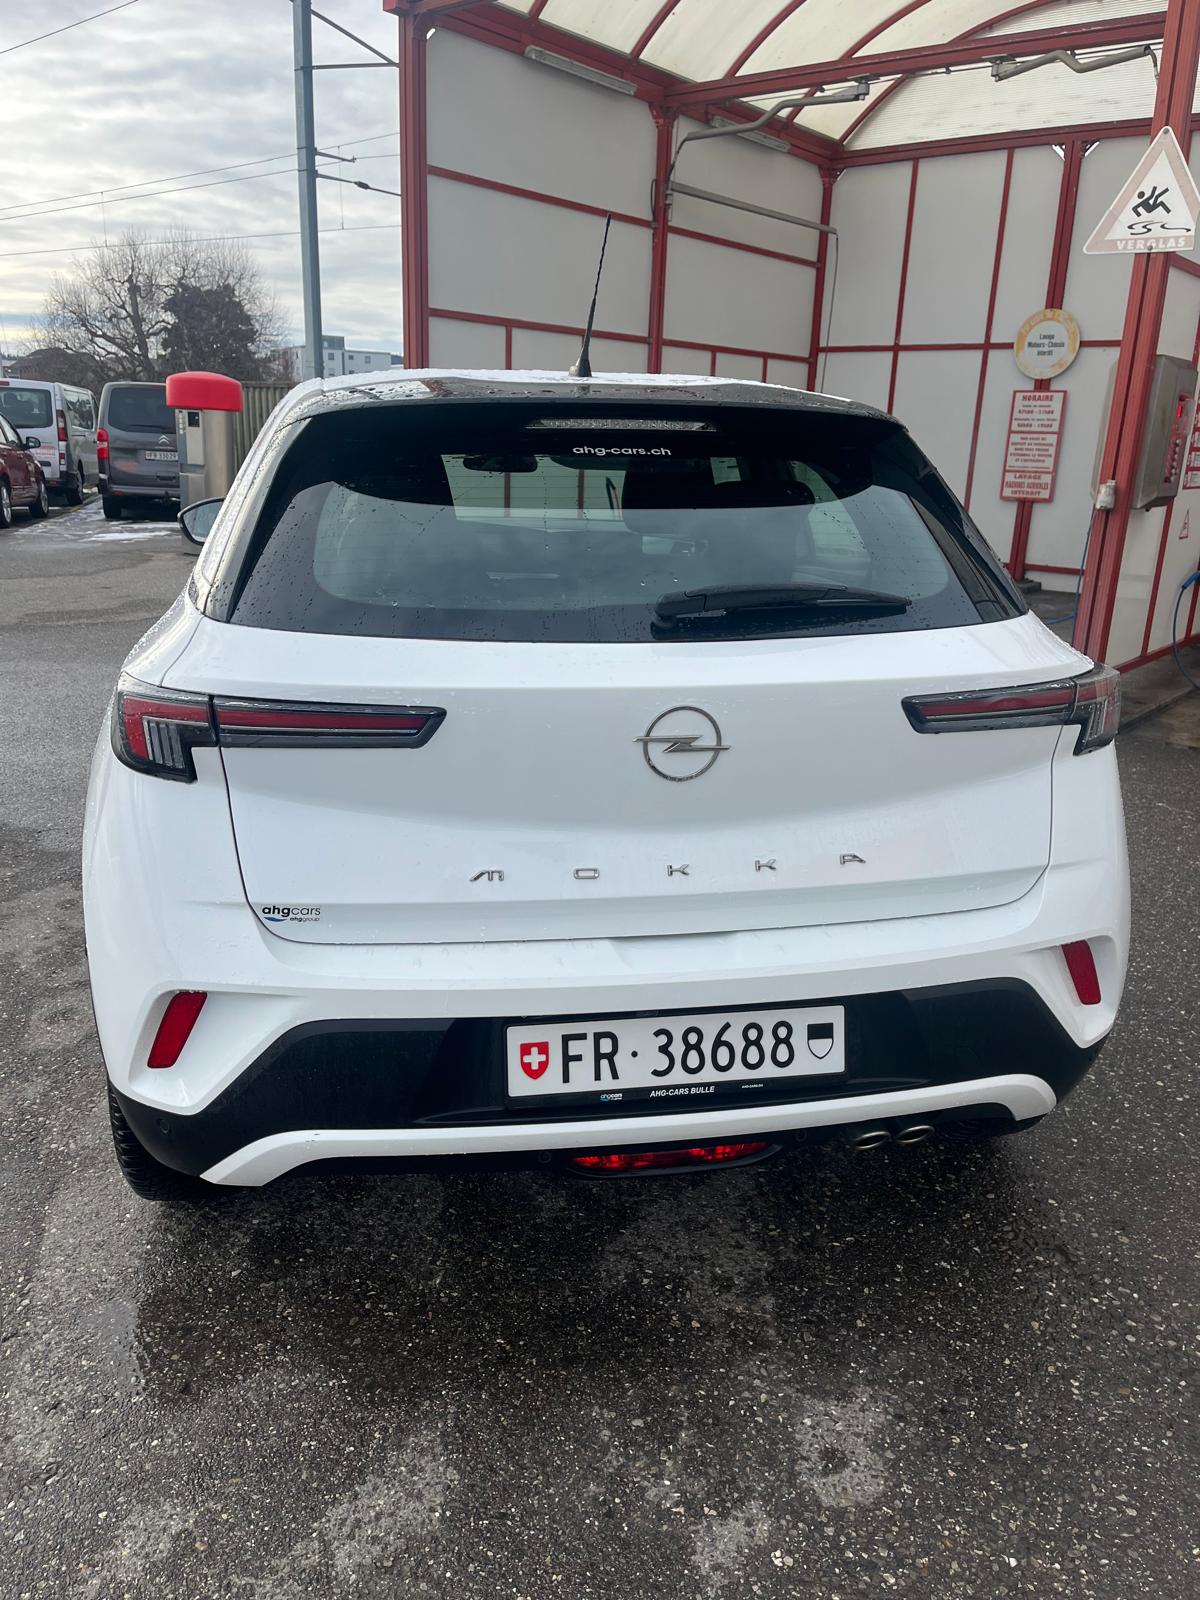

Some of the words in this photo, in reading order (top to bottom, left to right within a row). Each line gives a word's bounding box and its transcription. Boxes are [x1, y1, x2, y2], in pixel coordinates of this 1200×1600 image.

[1116, 237, 1186, 250] VERGLAS
[572, 446, 672, 456] ahg-cars.ch
[261, 905, 321, 918] ahgcars
[650, 1020, 795, 1078] 38688
[649, 1087, 690, 1098] AHG-CARS
[690, 1085, 715, 1094] BULLE
